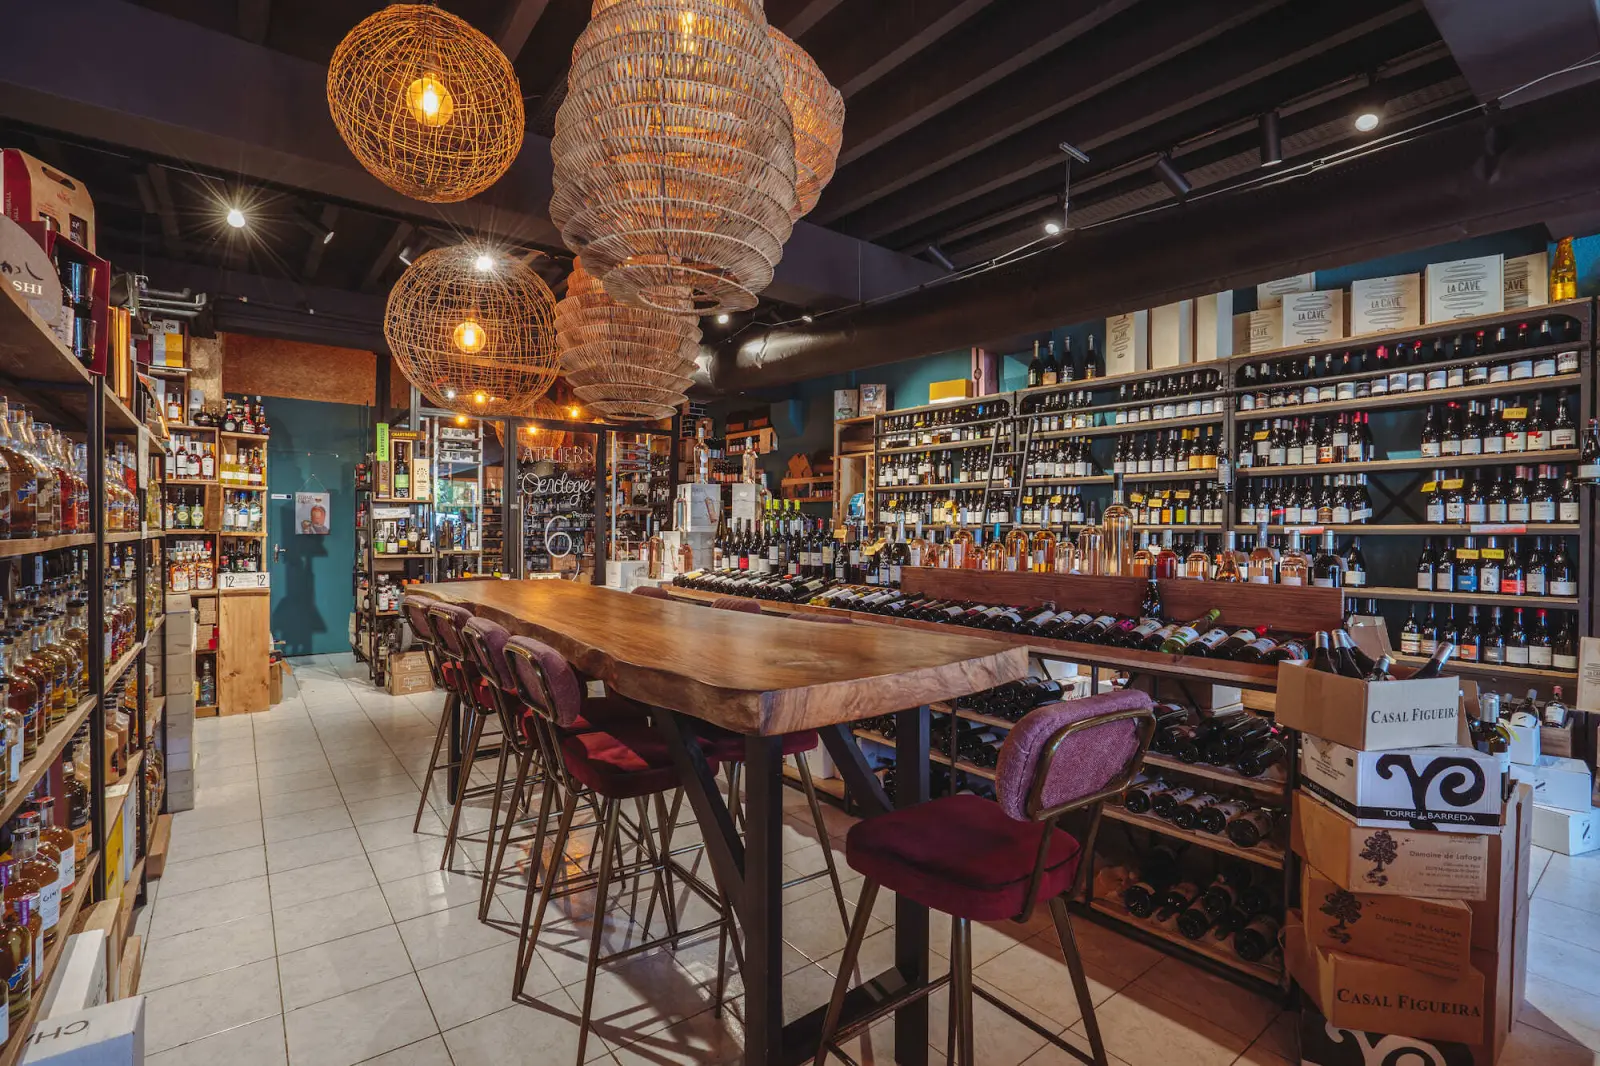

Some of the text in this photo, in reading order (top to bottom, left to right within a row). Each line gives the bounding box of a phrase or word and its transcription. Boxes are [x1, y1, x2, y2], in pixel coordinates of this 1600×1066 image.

[12, 280, 43, 296] SHI
[1447, 280, 1481, 293] LA CAVE
[1371, 297, 1402, 309] LA CAVE
[1298, 310, 1326, 321] LA CAVE
[521, 446, 593, 464] ATELIERS
[544, 515, 573, 558] 6
[225, 575, 235, 588] 12
[256, 574, 265, 586] 12
[1371, 710, 1409, 724] CASAL
[1383, 809, 1417, 819] TORRE
[1427, 812, 1476, 822] BARREDA
[1409, 850, 1442, 859] Domaine
[1456, 853, 1482, 861] Lafage
[1337, 988, 1481, 1018] CASAL FIGUEIRA
